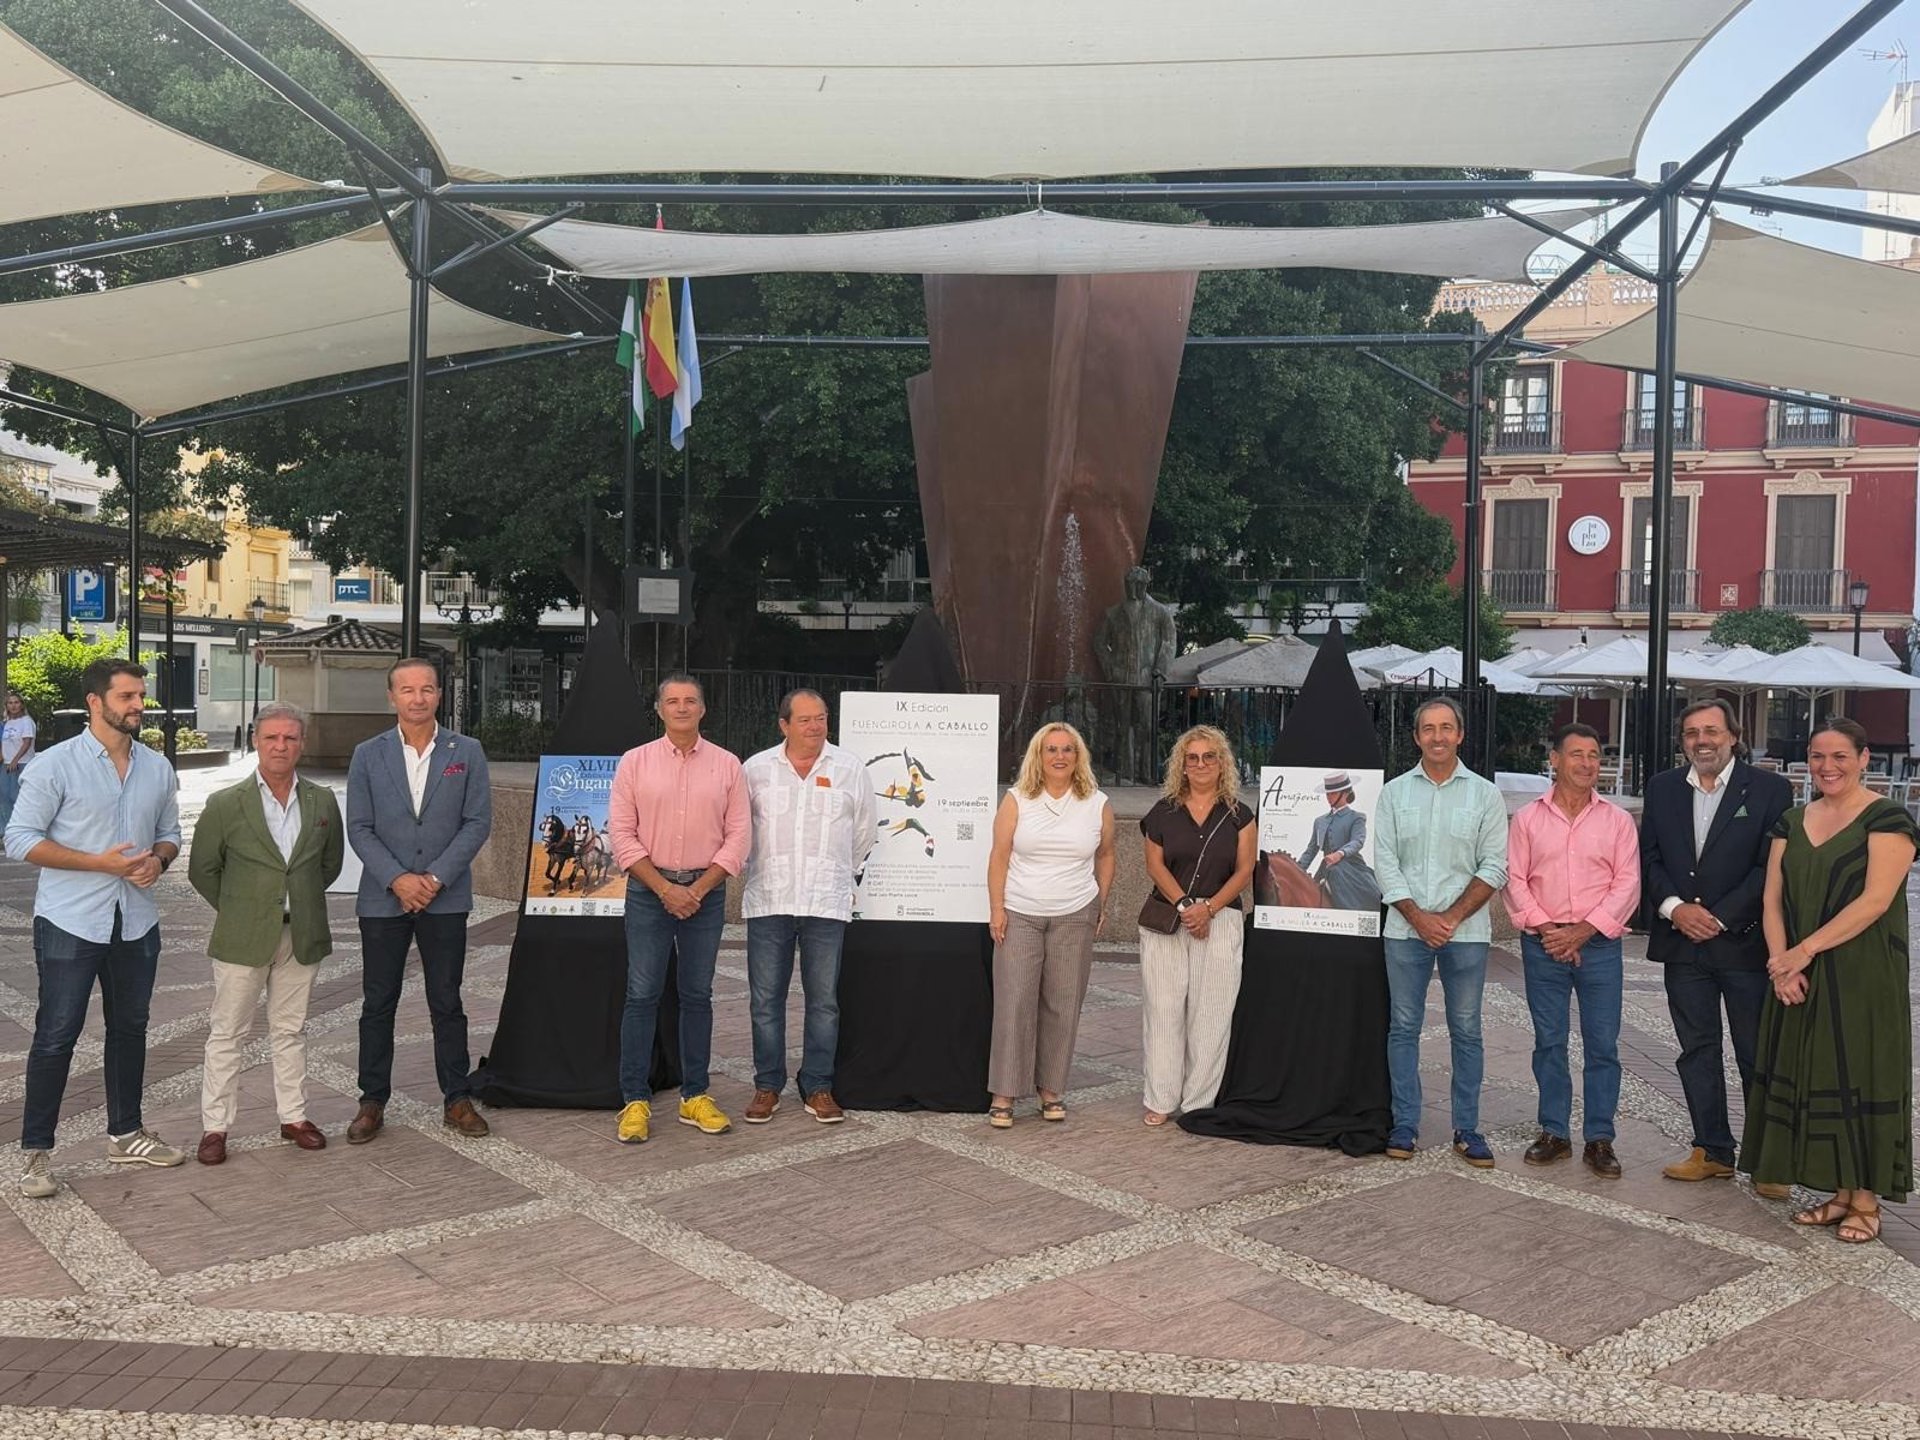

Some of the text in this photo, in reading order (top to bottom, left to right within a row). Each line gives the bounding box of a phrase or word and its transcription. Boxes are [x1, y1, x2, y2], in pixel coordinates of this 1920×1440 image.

[75, 569, 99, 601] P
[896, 700, 908, 711] IX
[852, 720, 989, 731] FUENGIROLA A CABALLO
[937, 799, 989, 809] 19 septiembre
